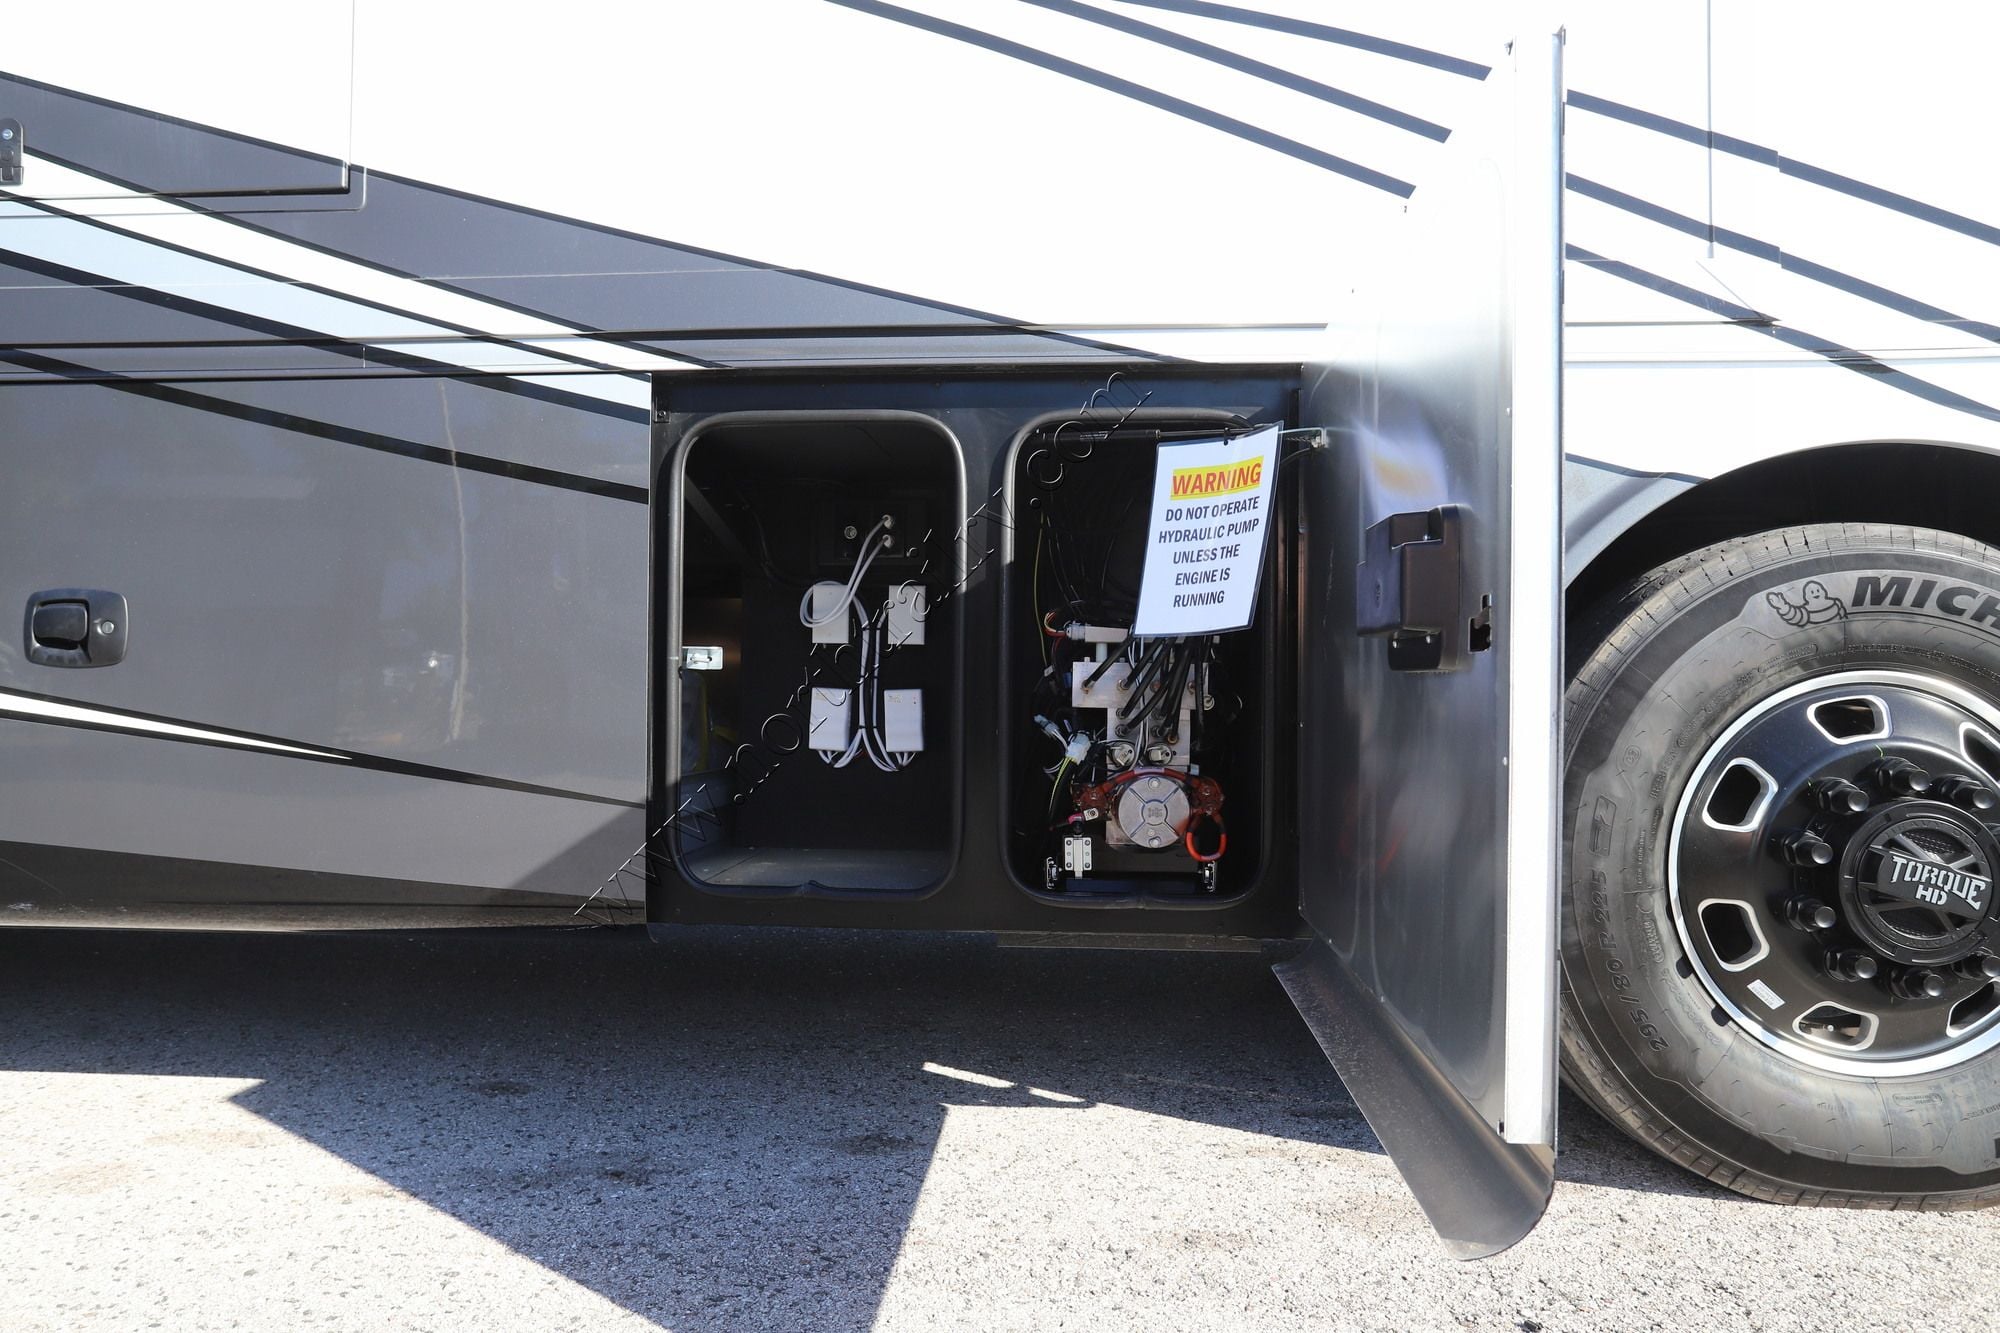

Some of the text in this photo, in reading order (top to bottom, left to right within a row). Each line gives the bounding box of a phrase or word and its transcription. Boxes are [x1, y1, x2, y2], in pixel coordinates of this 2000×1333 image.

[1172, 463, 1262, 496] WARNING
[1165, 496, 1260, 522] DO NOT OPERATE
[1158, 518, 1259, 544] HYDRAULIC PUMP
[1173, 544, 1240, 564] UNLESS THE
[1175, 567, 1230, 586] ENGINE IS
[1173, 590, 1225, 608] RUNNING
[1890, 856, 1986, 910] TORQUE
[1915, 884, 1948, 905] HD
